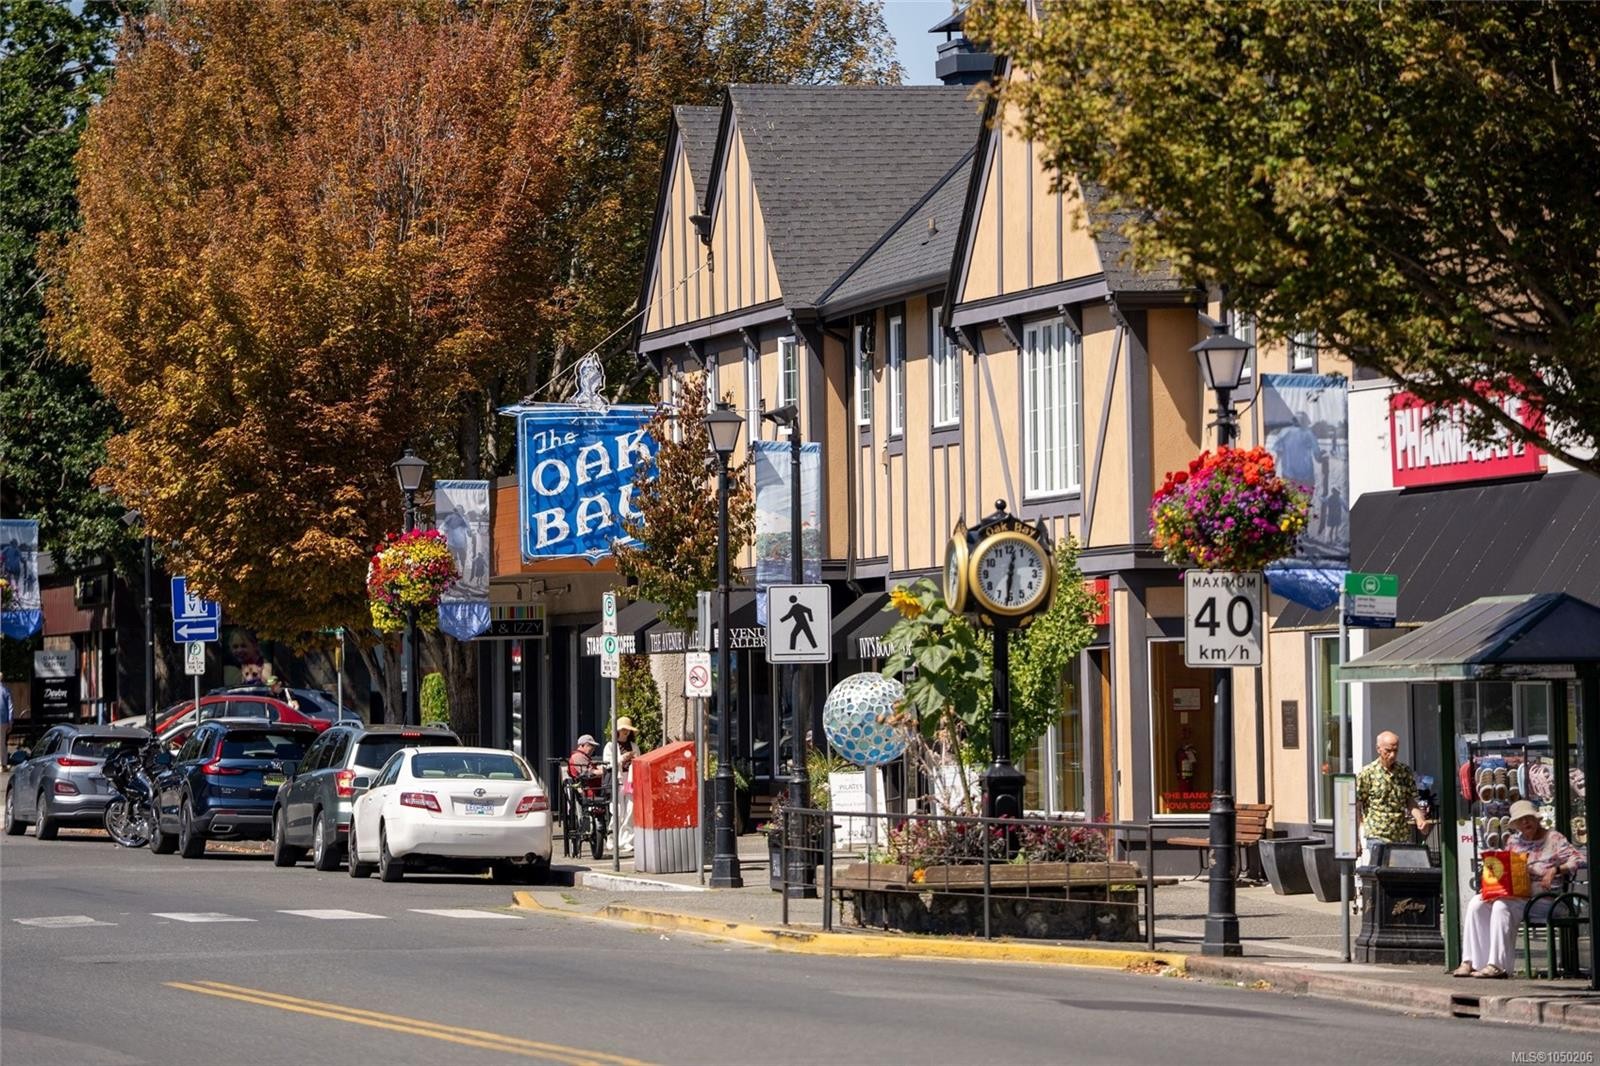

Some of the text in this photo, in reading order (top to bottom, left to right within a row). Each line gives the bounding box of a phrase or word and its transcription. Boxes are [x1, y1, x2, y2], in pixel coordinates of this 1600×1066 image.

[533, 429, 579, 454] The
[531, 429, 655, 497] OAK
[986, 522, 1036, 537] Oak Bay
[995, 549, 1002, 558] 11
[1004, 545, 1015, 555] 12
[1019, 549, 1024, 557] 1
[986, 559, 996, 567] 10
[1028, 558, 1034, 567] 2
[983, 569, 989, 579] 9
[1032, 569, 1038, 578] 3
[986, 581, 993, 591] 8
[1027, 581, 1033, 590] 4
[1192, 576, 1256, 588] MAXIMUM
[996, 590, 1001, 599] 7
[1019, 589, 1025, 599] 5
[1194, 596, 1254, 637] 40
[513, 622, 541, 634] IZZY
[730, 627, 767, 639] VENU
[586, 636, 601, 656] STAR
[650, 633, 661, 652] THE
[662, 631, 683, 651] AVENUE
[730, 637, 767, 648] ALLER
[1199, 644, 1250, 662] km/h
[1183, 791, 1208, 799] BANK
[1190, 801, 1213, 810] SCOT
